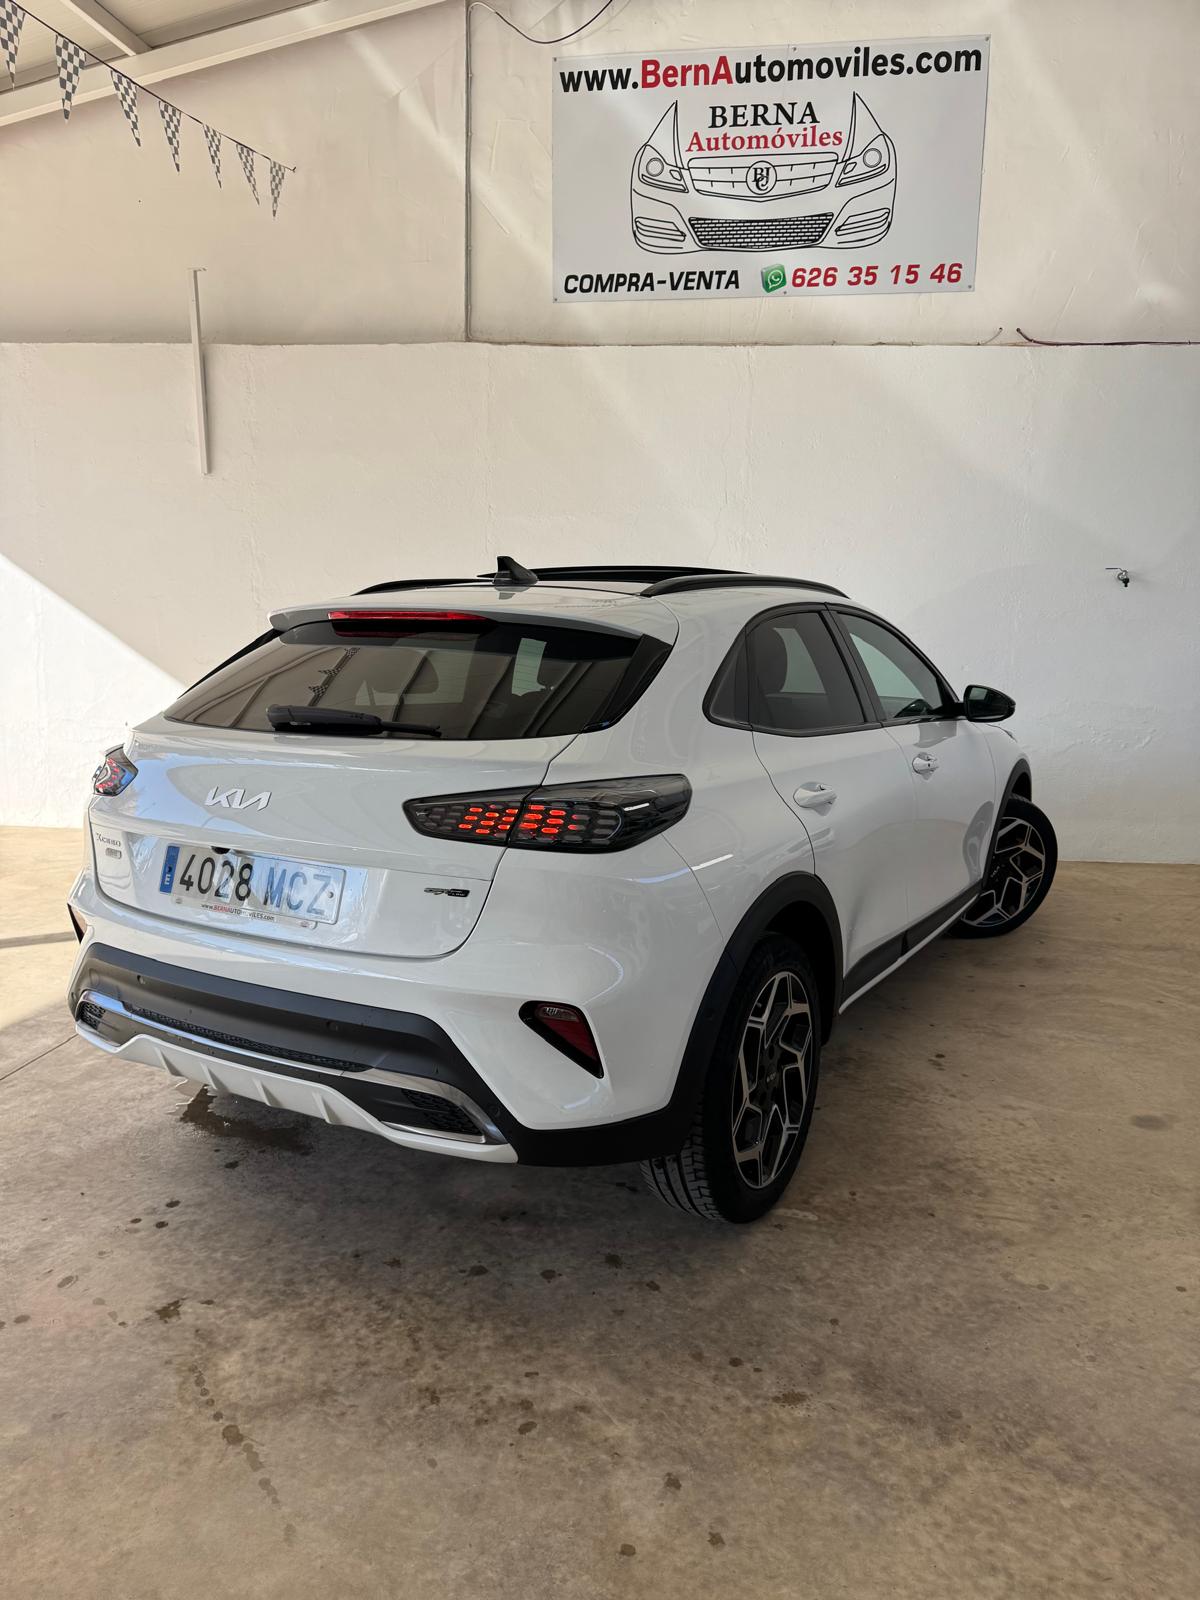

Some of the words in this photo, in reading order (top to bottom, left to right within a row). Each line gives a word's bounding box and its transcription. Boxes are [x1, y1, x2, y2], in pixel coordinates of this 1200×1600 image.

[559, 47, 982, 92] www.BernAutomoviles.com
[708, 101, 820, 128] BERNA
[685, 125, 844, 152] Automóviles
[564, 270, 740, 294] COMPRA-VENTA
[791, 267, 837, 288] 626
[847, 265, 878, 286] 35
[889, 264, 920, 284] 15
[930, 262, 962, 283] 46
[179, 854, 253, 901] 4028
[263, 867, 332, 915] MCZ
[201, 903, 275, 921] www.BERNAUTOVILES.com
